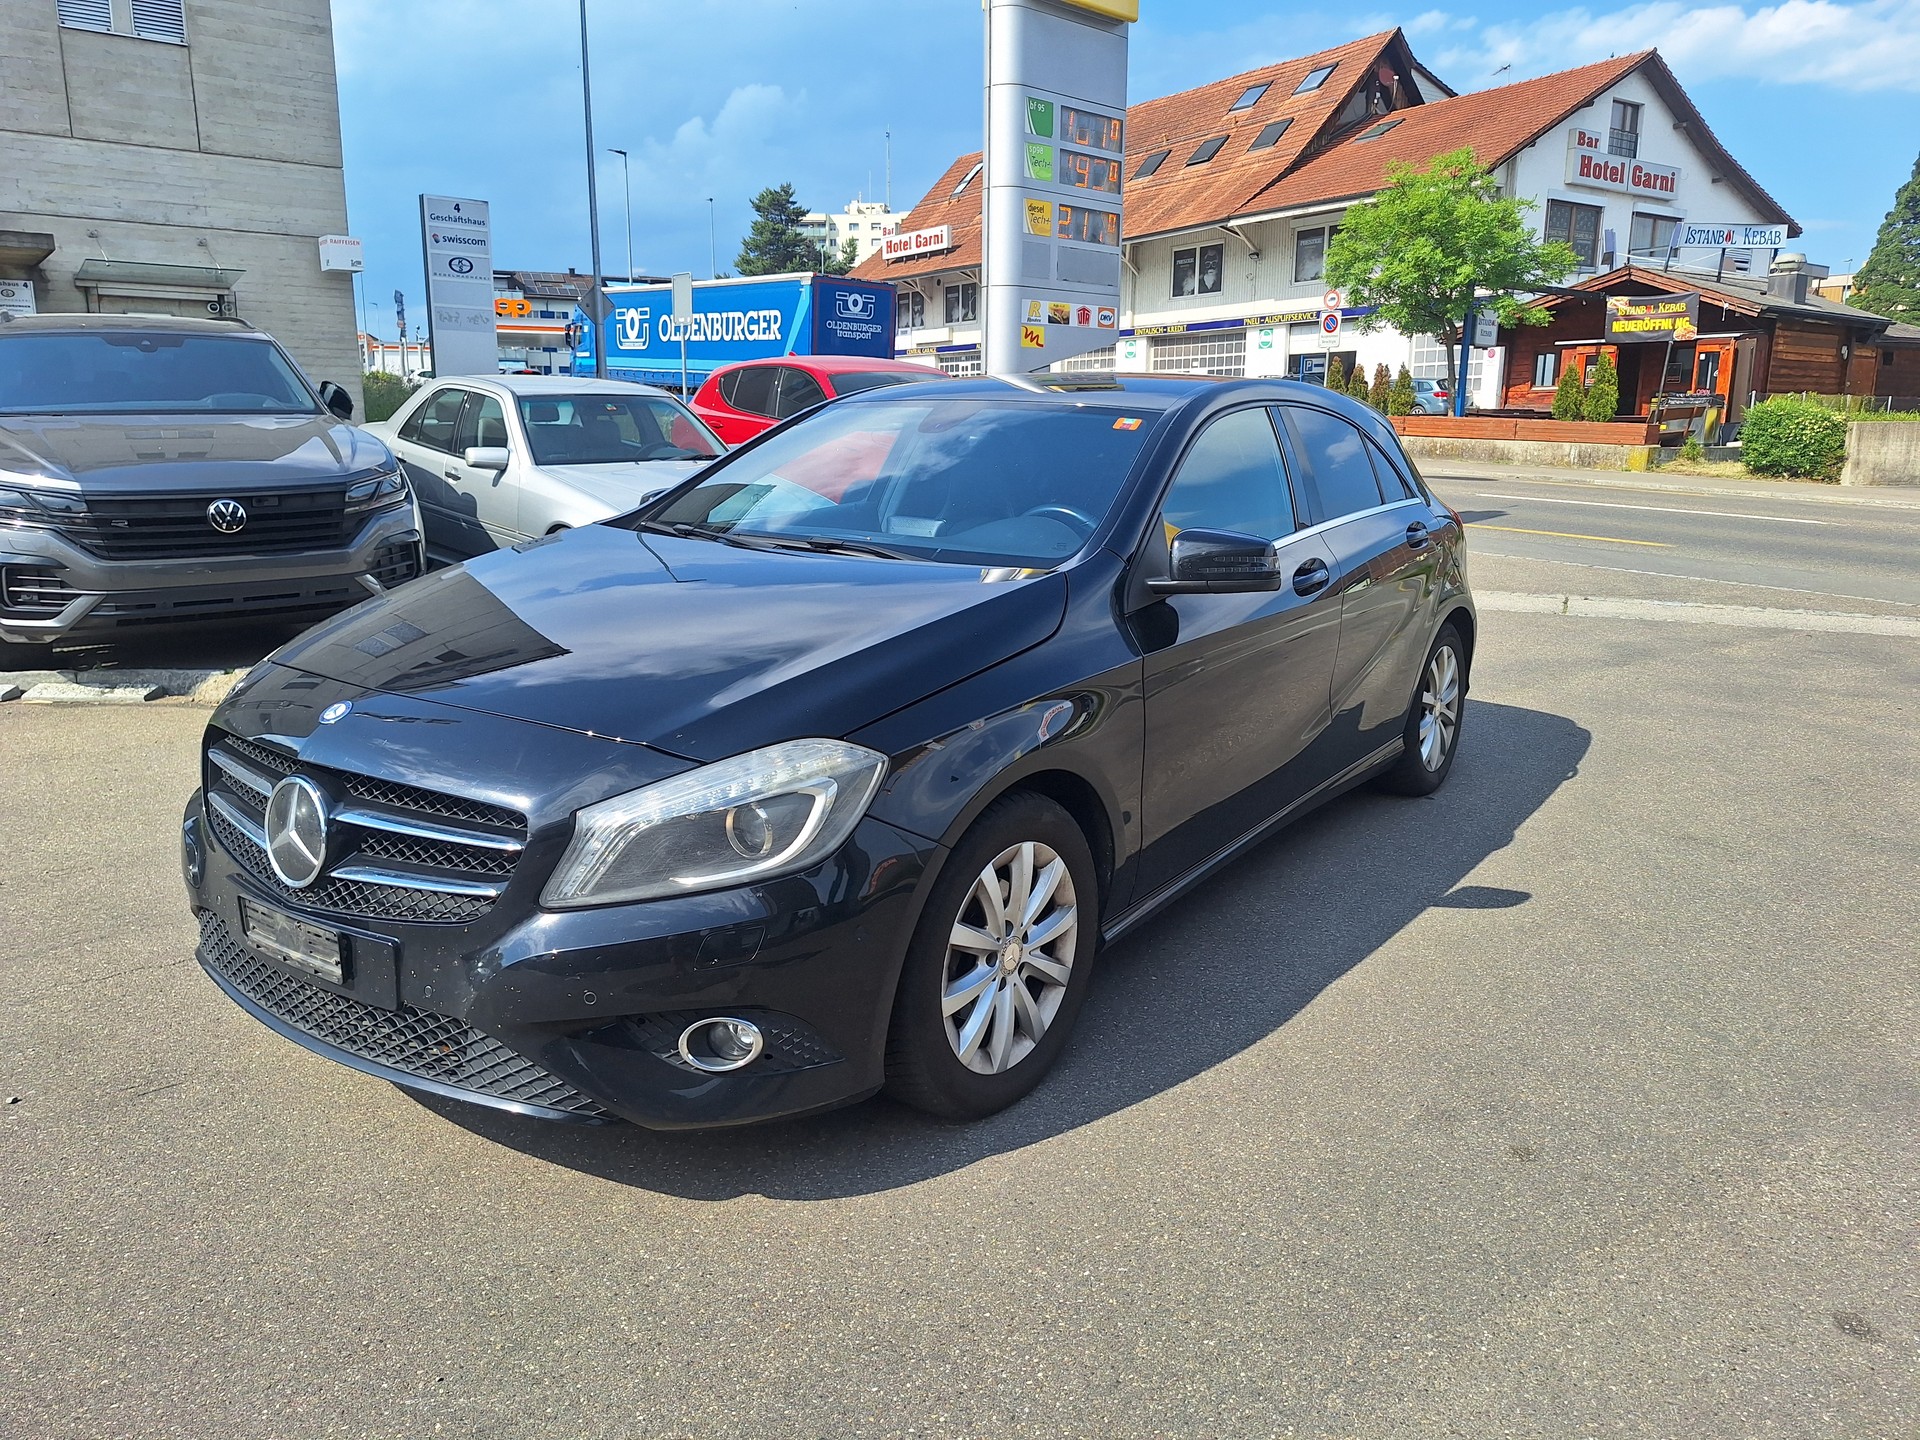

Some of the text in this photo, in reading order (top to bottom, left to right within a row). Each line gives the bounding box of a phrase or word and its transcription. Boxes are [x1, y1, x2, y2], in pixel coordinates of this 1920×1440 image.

[1029, 101, 1045, 112] bf 95
[1577, 131, 1599, 149] Bar
[1579, 155, 1676, 193] Hotel Garni
[454, 203, 461, 213] 4
[1028, 203, 1045, 214] diesel
[430, 213, 486, 226] Geschäftshaus
[882, 227, 894, 236] Bar
[1743, 227, 1782, 245] KEBAB
[442, 234, 487, 247] swisscom
[886, 229, 944, 254] Hotel Garni
[22, 281, 29, 289] 4
[1658, 302, 1687, 314] KEBAB
[1100, 313, 1113, 322] DKV
[826, 320, 882, 333] OLDENBURGER
[837, 329, 872, 340] transport
